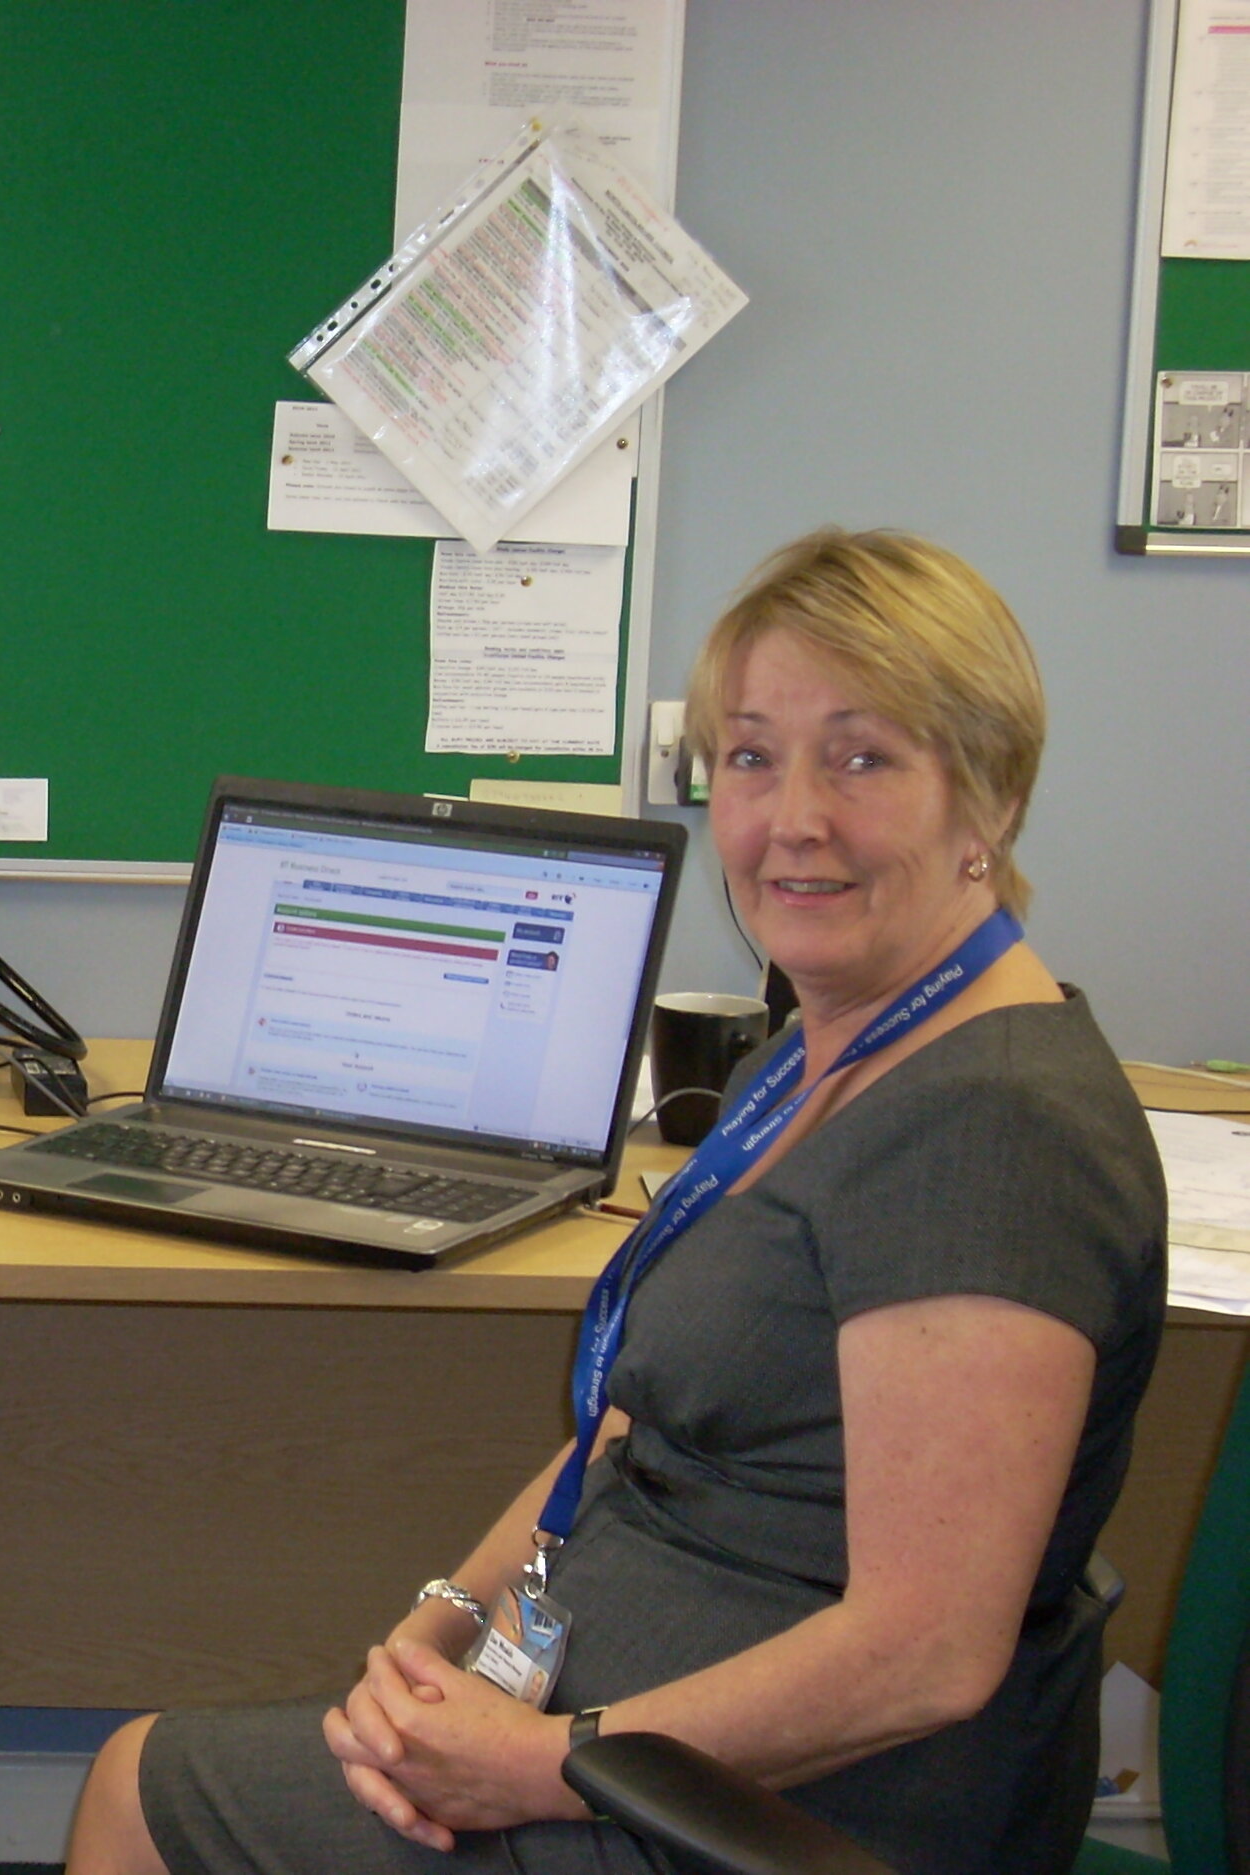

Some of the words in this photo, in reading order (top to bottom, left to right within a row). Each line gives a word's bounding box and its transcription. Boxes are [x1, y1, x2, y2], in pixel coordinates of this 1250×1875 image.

[923, 963, 964, 999] Playing
[910, 995, 927, 1012] for
[863, 1007, 911, 1045] Success
[721, 1100, 757, 1137] Playing
[752, 1086, 769, 1103] for
[765, 1046, 807, 1089] Success
[741, 1115, 784, 1152] Strength
[682, 1173, 720, 1209] Playing
[672, 1207, 687, 1225] for
[595, 1355, 605, 1368] to
[587, 1370, 603, 1418] Strength
